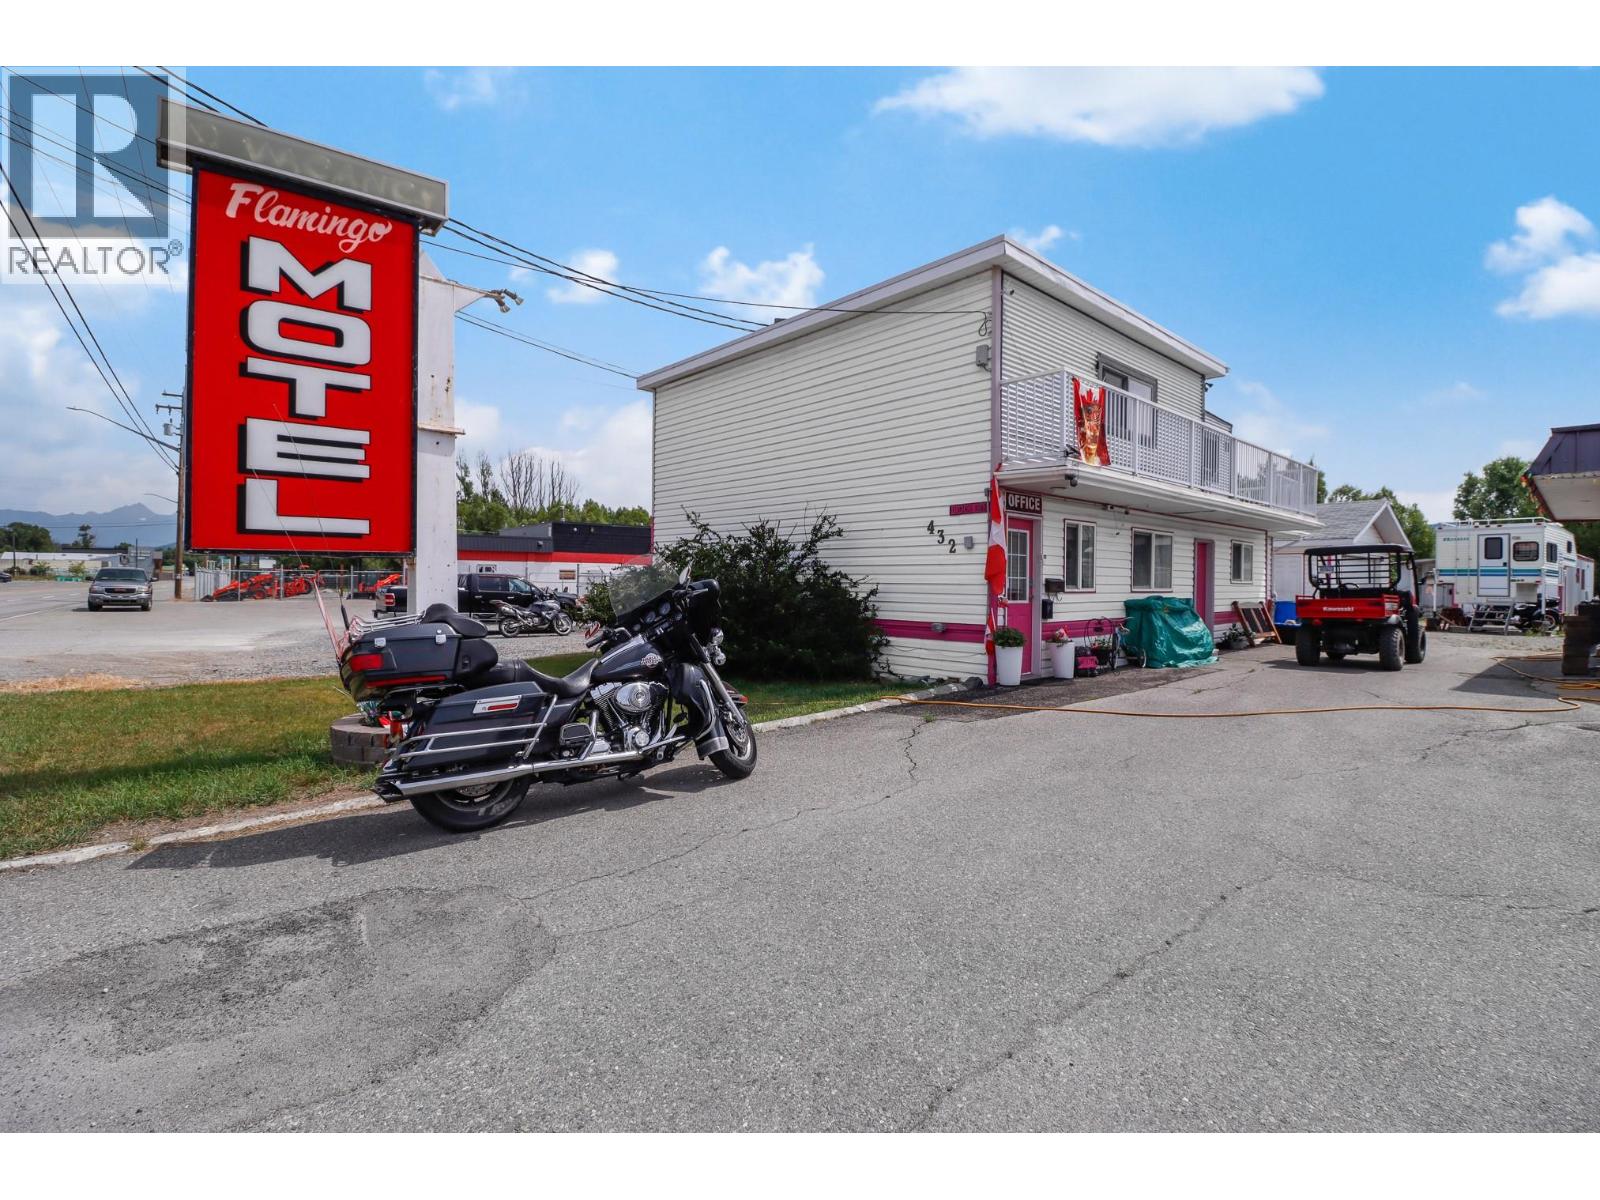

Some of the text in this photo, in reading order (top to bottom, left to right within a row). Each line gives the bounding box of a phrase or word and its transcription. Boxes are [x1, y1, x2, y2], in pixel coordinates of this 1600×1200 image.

[225, 182, 393, 253] Flamingo
[240, 235, 372, 537] MOTEL
[1008, 493, 1041, 511] OFFICE
